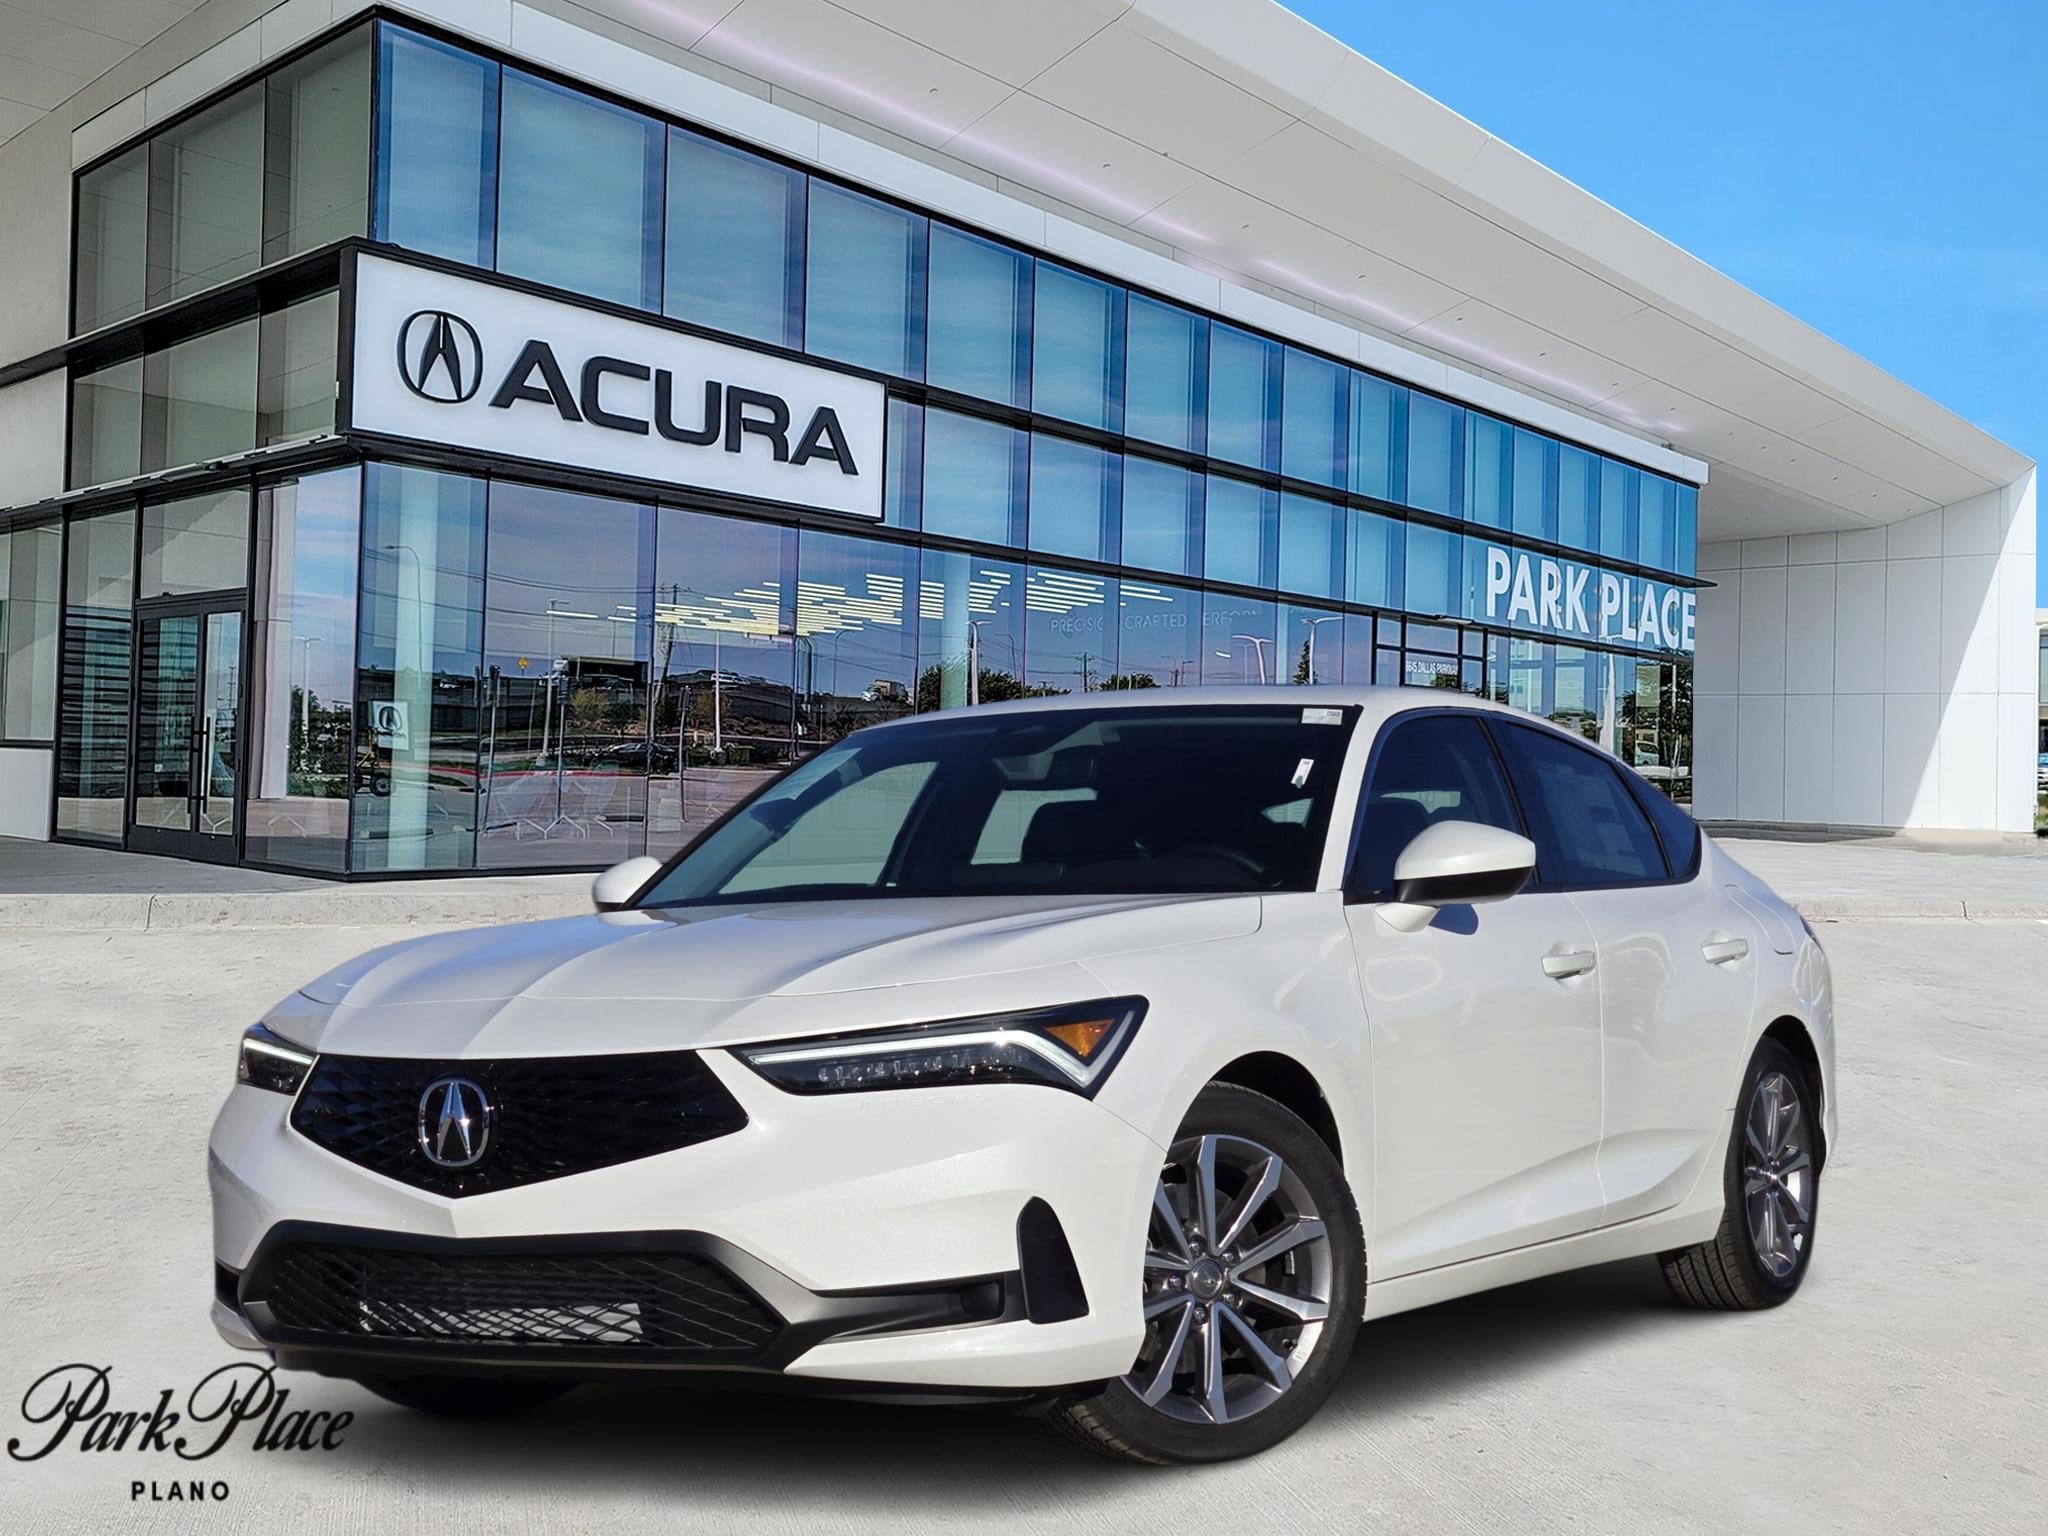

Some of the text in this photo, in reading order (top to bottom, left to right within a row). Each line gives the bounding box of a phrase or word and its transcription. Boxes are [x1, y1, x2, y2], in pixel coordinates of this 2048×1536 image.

[487, 339, 860, 476] ACURA
[1125, 613, 1188, 630] CRAFTED
[1486, 546, 1696, 650] PARK PLACE
